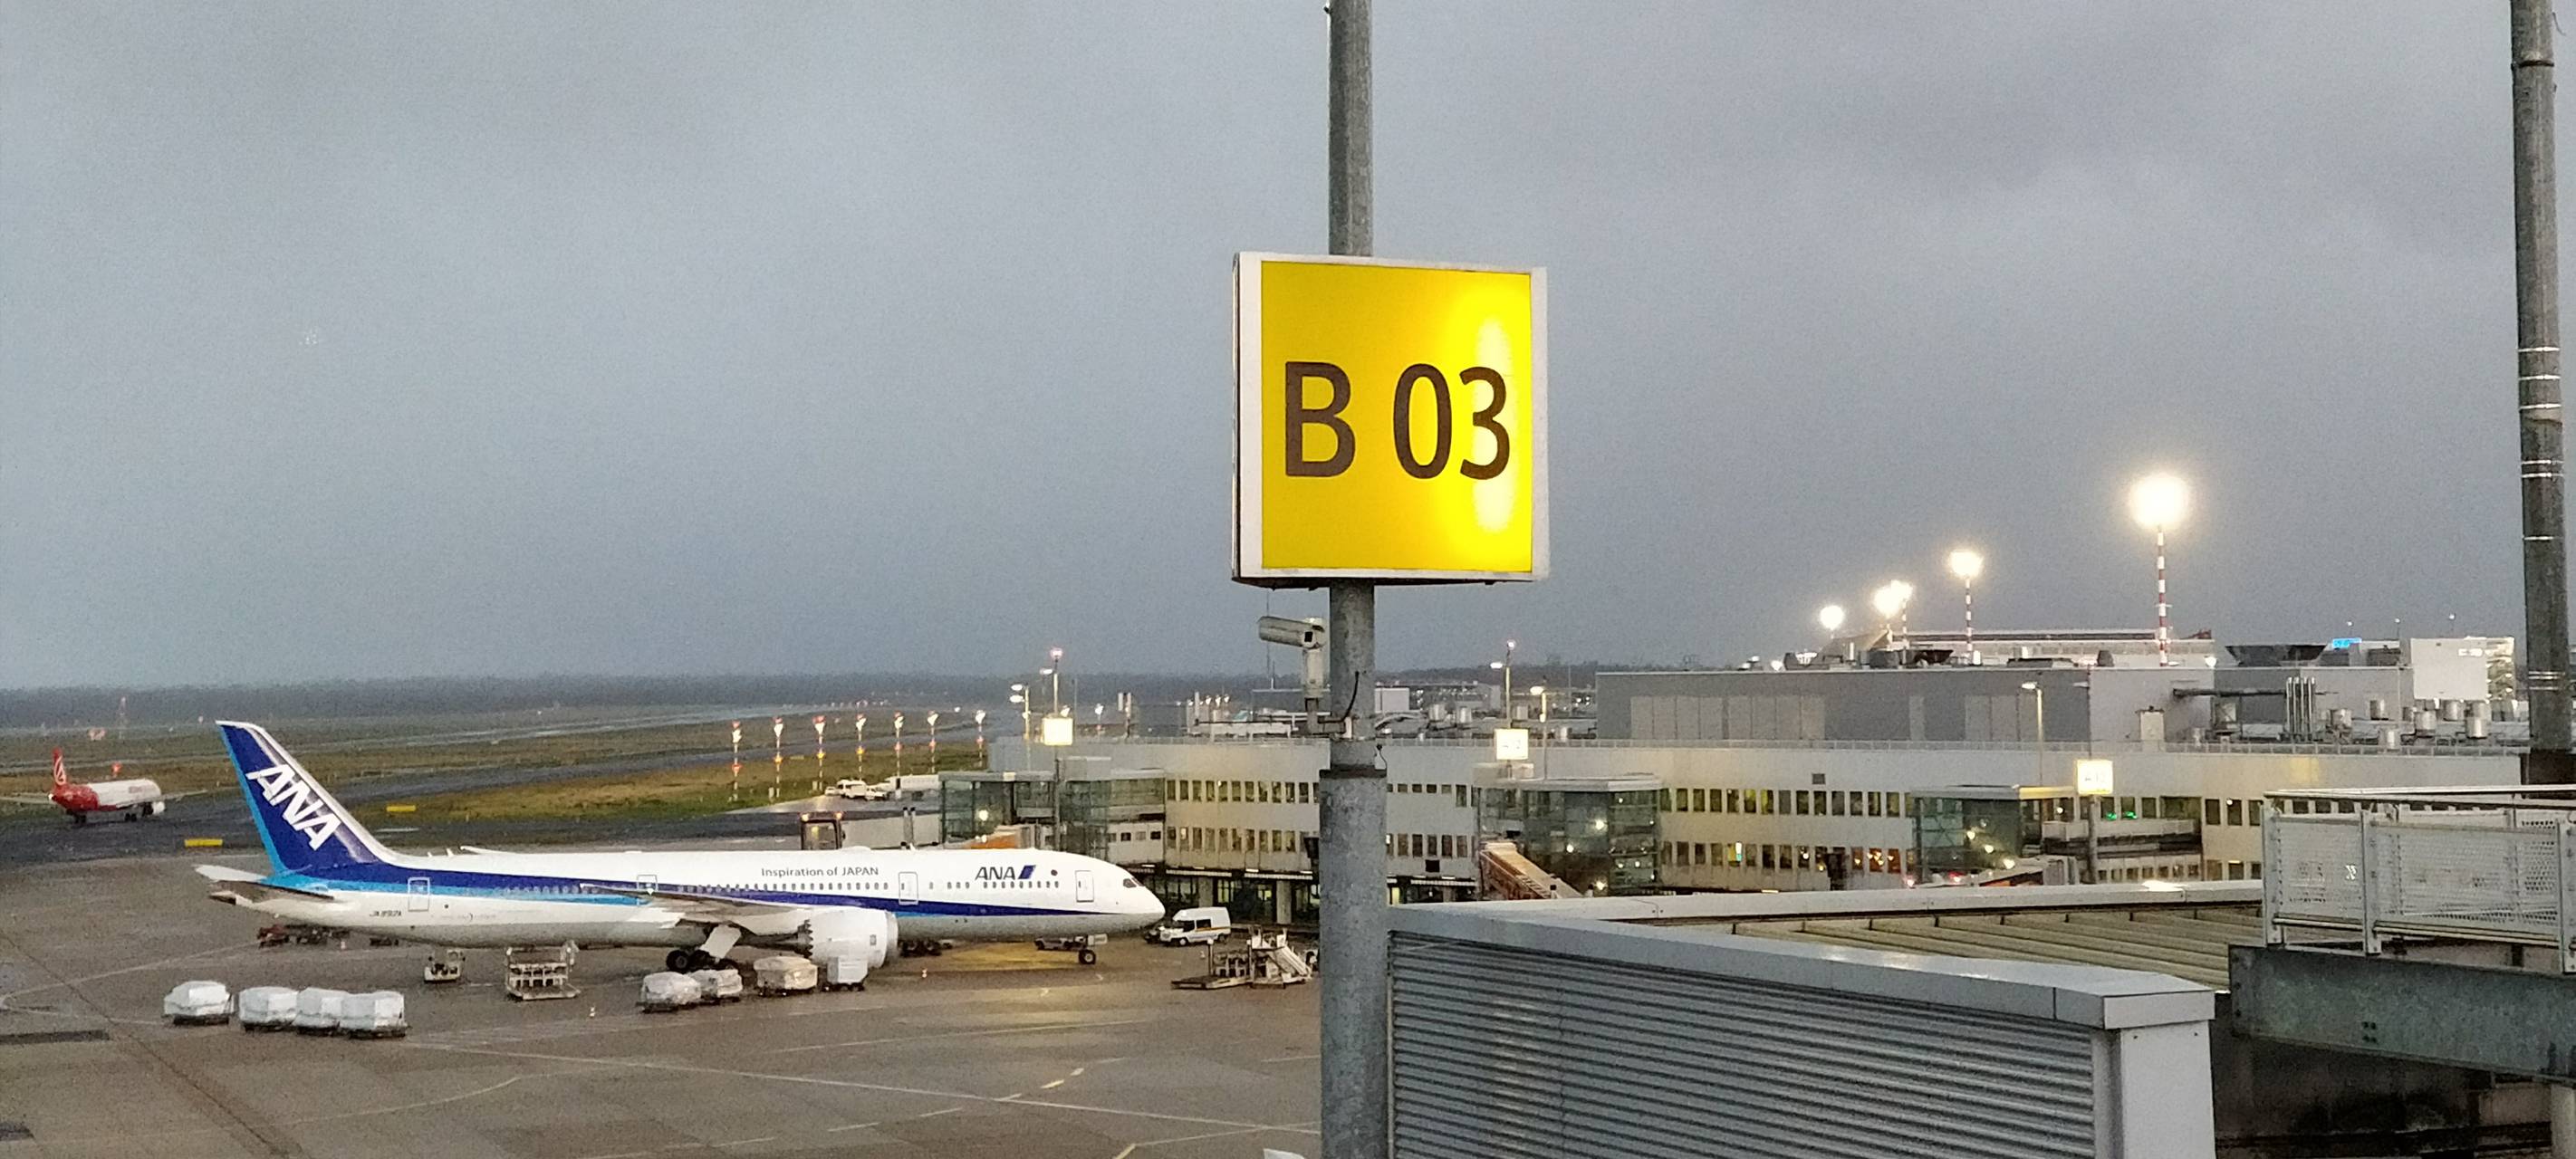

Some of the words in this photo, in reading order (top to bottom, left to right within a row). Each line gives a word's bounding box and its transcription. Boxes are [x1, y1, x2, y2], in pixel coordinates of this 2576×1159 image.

[1284, 360, 1356, 478] B
[1393, 363, 1511, 481] 03
[245, 763, 341, 851] ANA
[761, 867, 824, 877] Inspiration
[826, 867, 839, 876] of
[841, 866, 879, 876] JAPAN
[974, 866, 1015, 880] ANA
